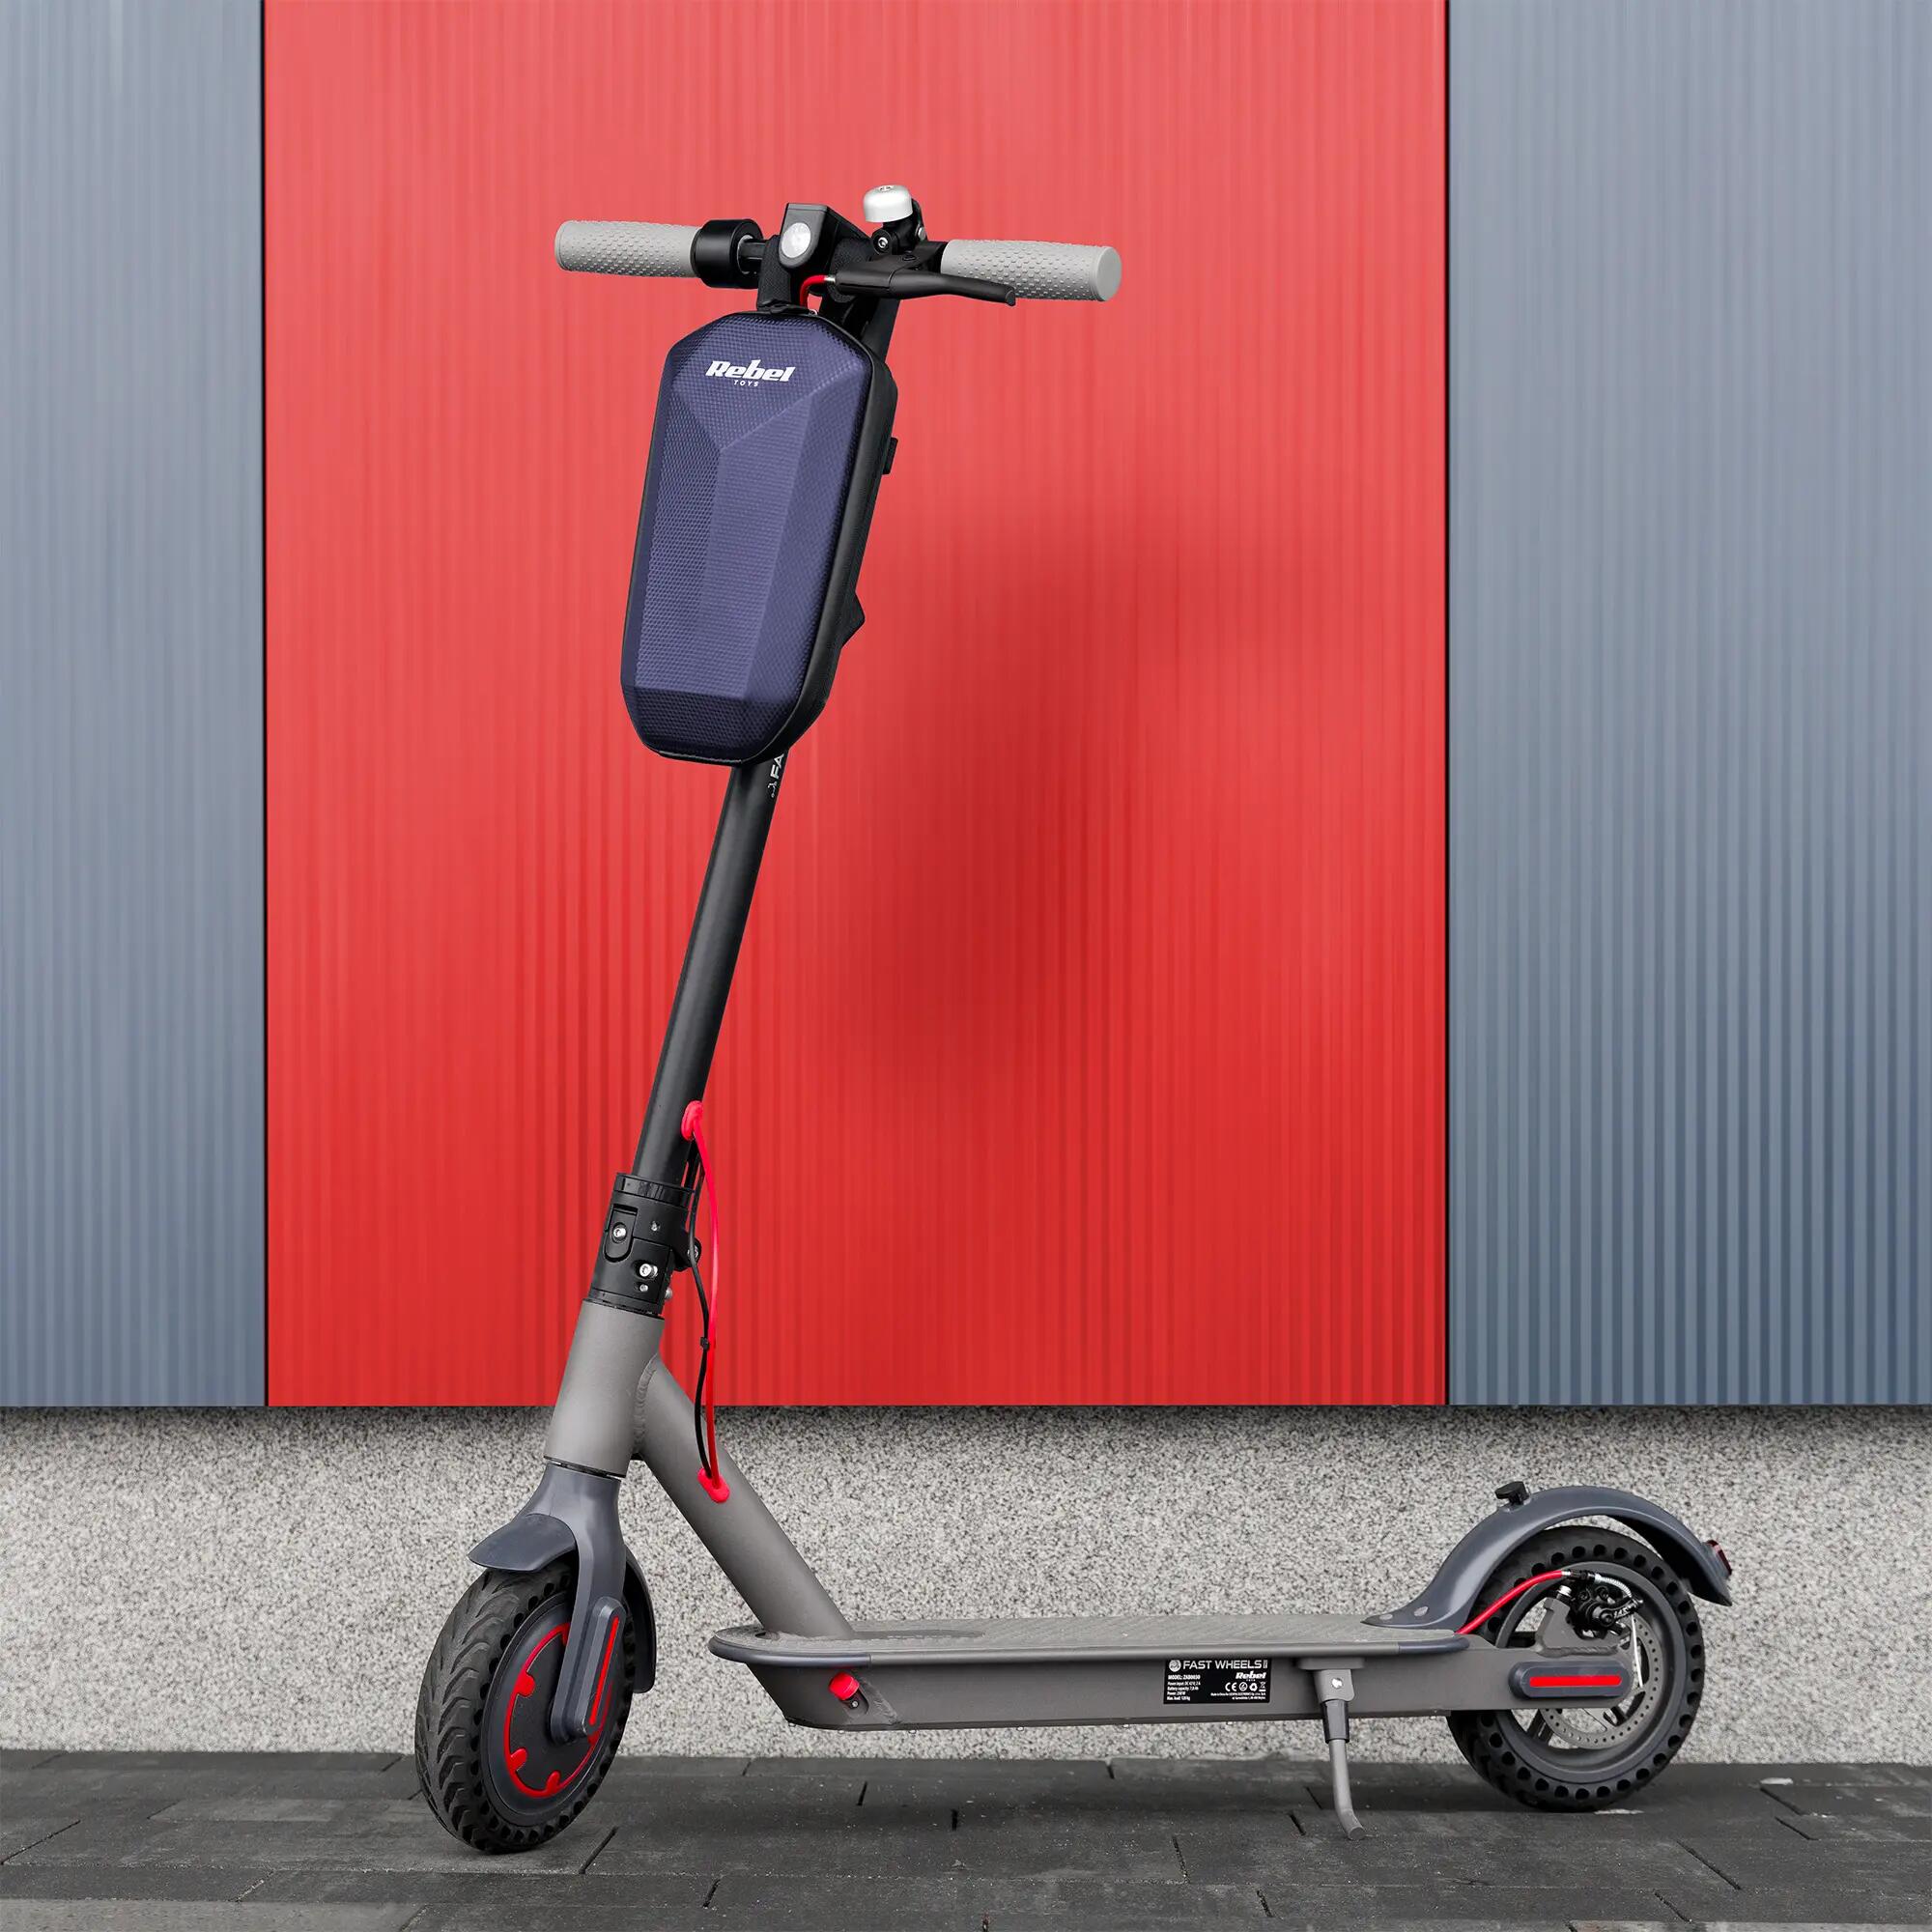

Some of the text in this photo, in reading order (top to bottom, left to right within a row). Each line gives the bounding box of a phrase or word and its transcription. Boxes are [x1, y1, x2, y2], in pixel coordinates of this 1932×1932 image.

[705, 359, 796, 382] Rebel
[1182, 1660, 1212, 1669] FAST
[1214, 1660, 1263, 1669] WHEELS
[1236, 1670, 1267, 1679] Rebel
